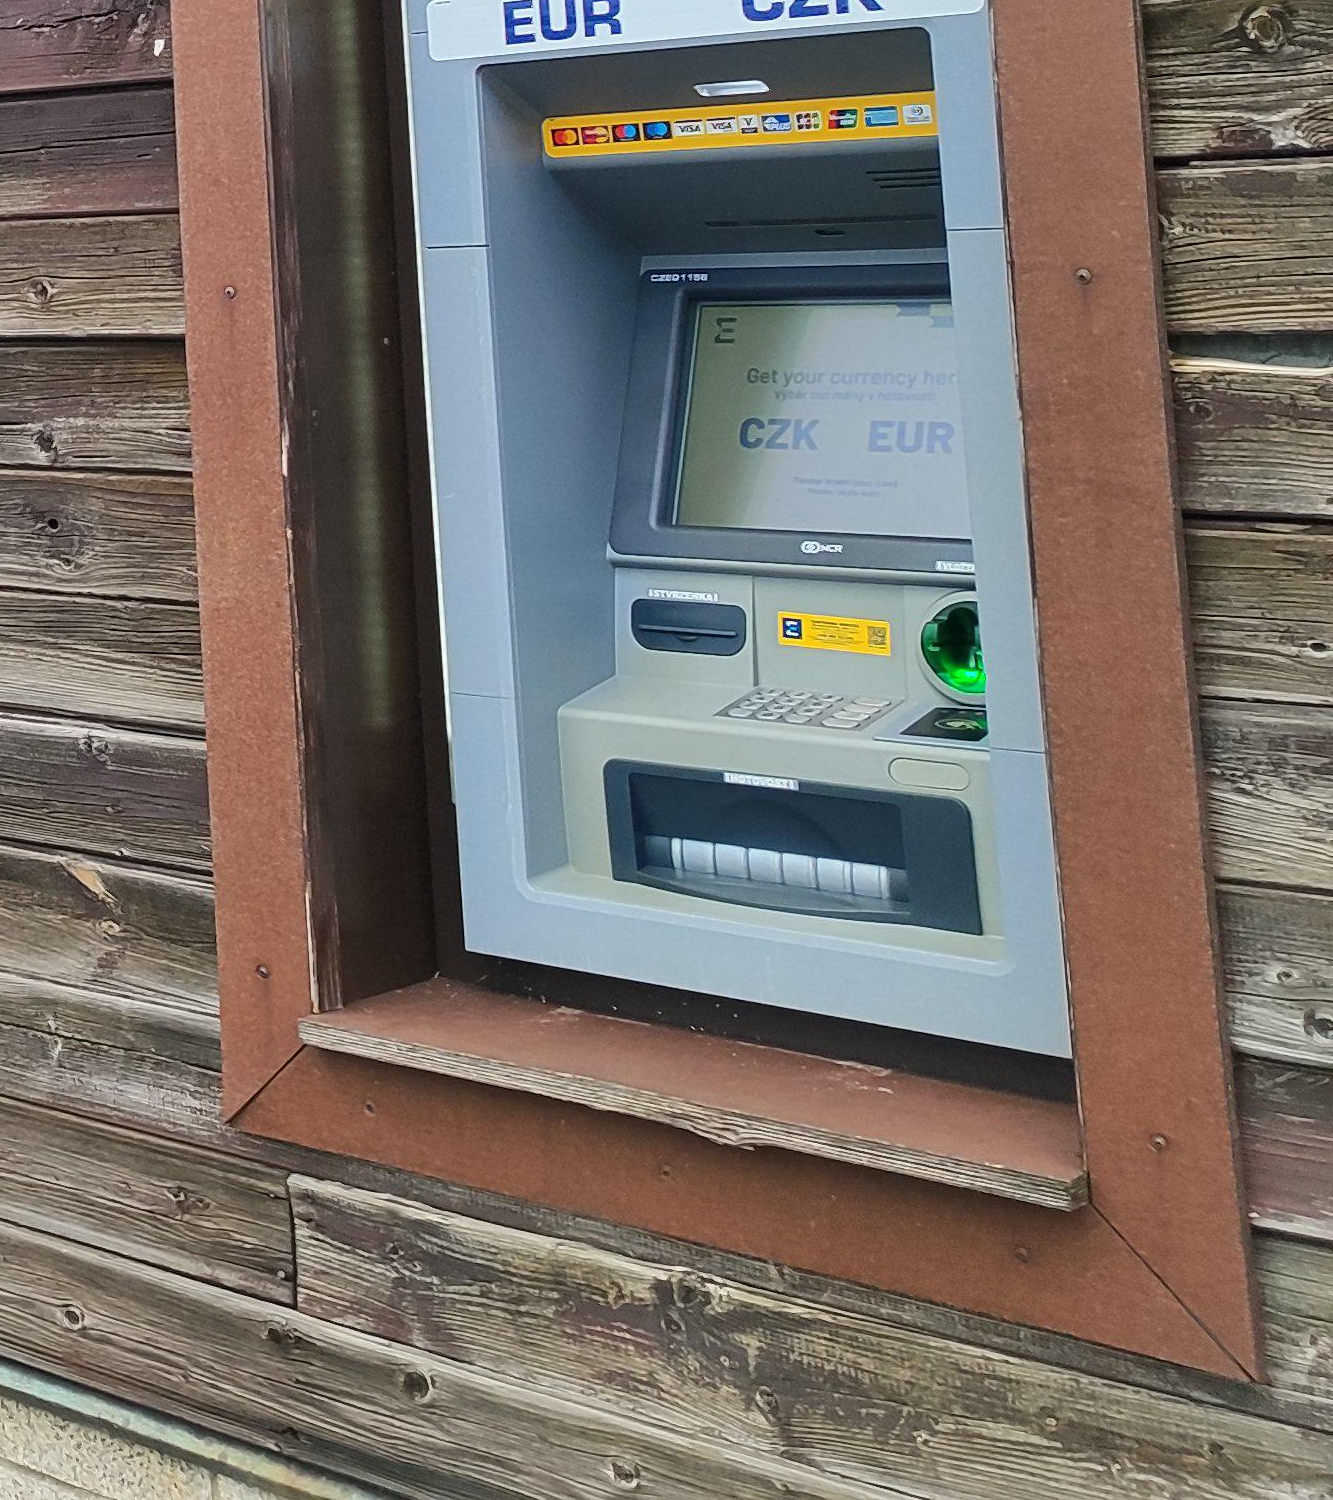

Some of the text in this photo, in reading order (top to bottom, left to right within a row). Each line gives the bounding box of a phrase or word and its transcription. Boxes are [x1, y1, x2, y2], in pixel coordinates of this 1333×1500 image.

[747, 367, 957, 389] Get your currency her
[739, 417, 956, 454] CZK EUR
